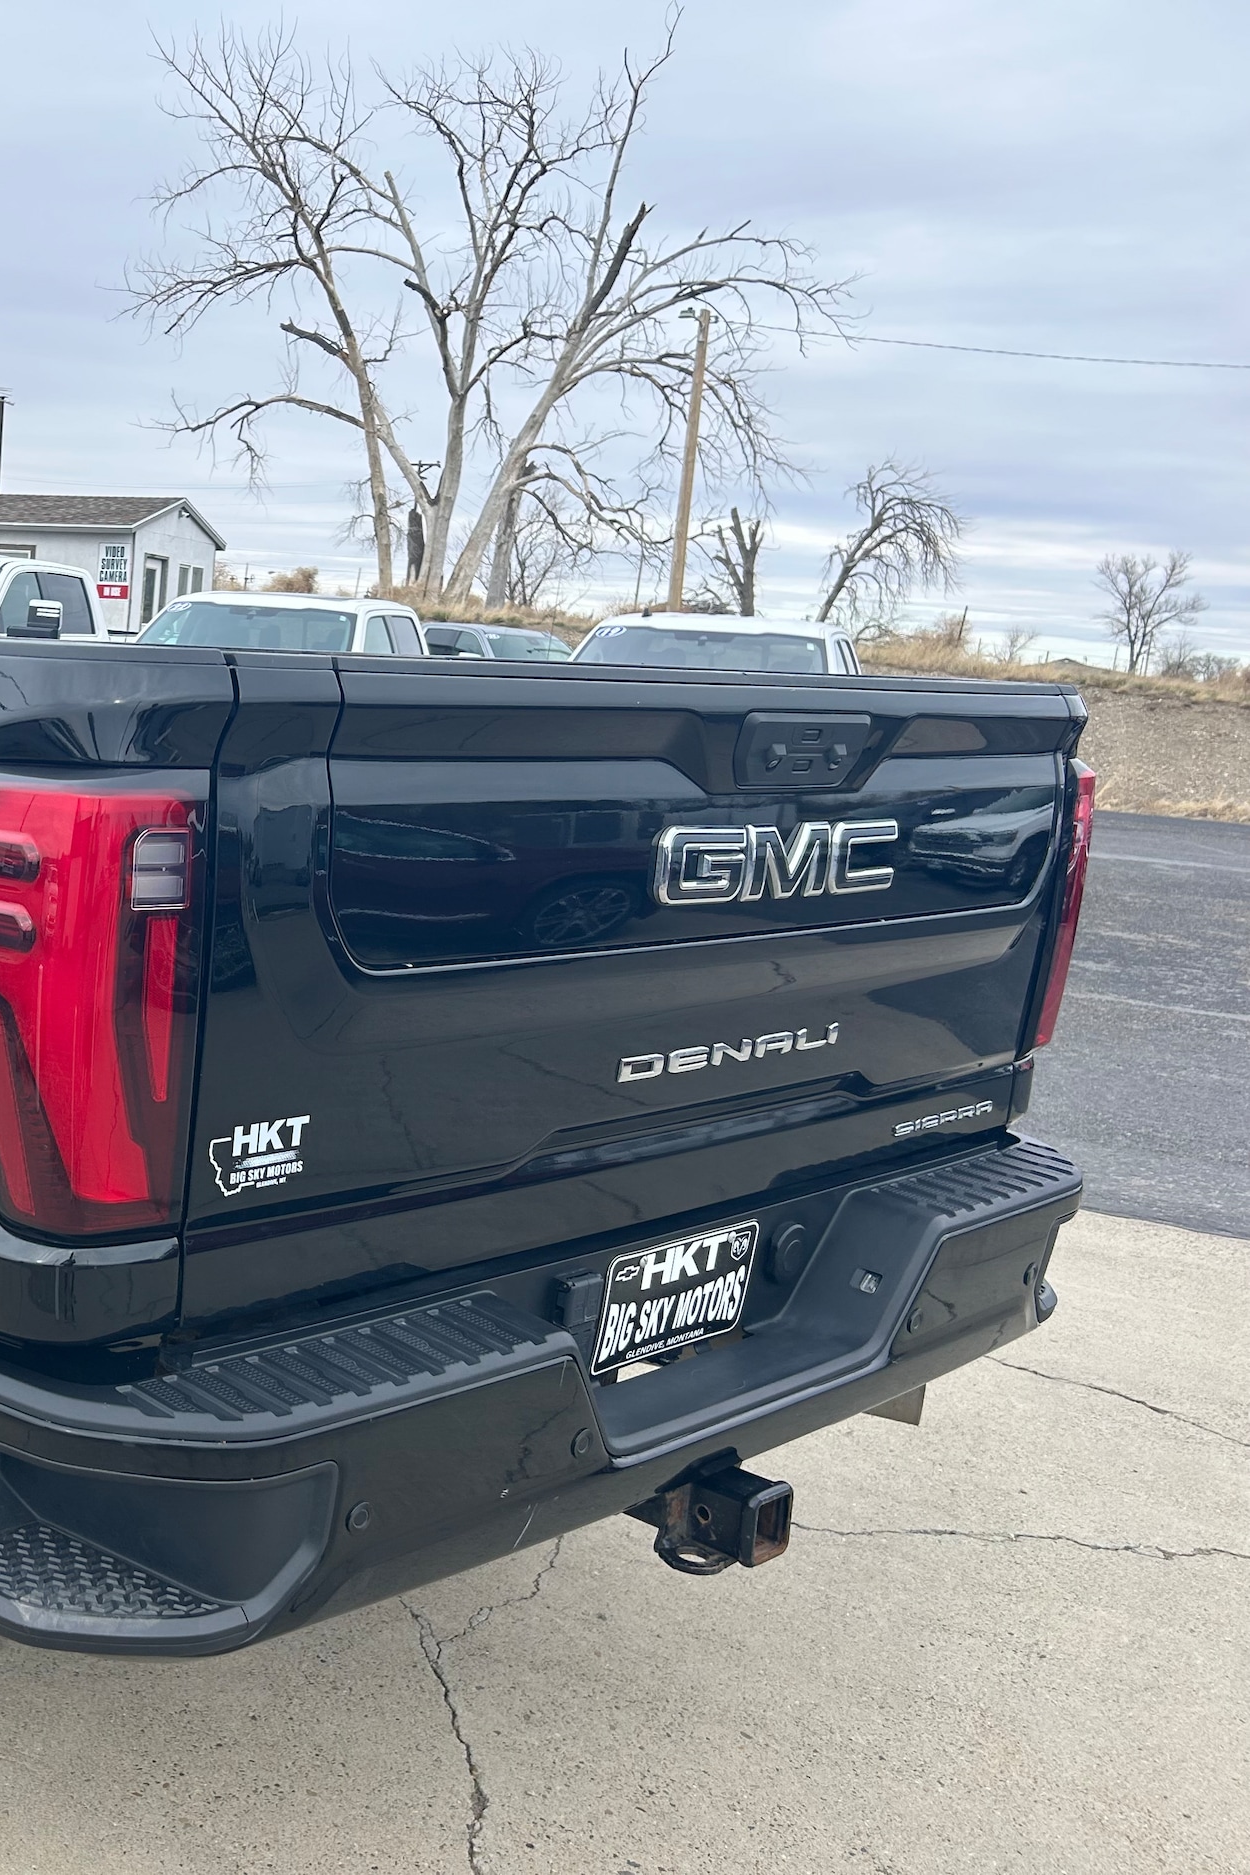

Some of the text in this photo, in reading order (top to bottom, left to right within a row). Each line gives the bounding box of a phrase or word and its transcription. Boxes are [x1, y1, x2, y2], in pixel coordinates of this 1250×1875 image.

[101, 558, 128, 570] SURVEY
[105, 546, 125, 557] VIDEO
[99, 571, 127, 582] CAMERA
[653, 819, 898, 906] GMC
[617, 1022, 839, 1083] DENALI
[232, 1115, 310, 1157] HKT
[891, 1100, 993, 1137] SIERRA
[230, 1161, 303, 1184] BIG SKY MOTORS
[640, 1233, 729, 1290] HKT
[598, 1265, 746, 1363] BIG SKY MOTORS
[626, 1328, 705, 1360] GLENDIVE, MONTANA
